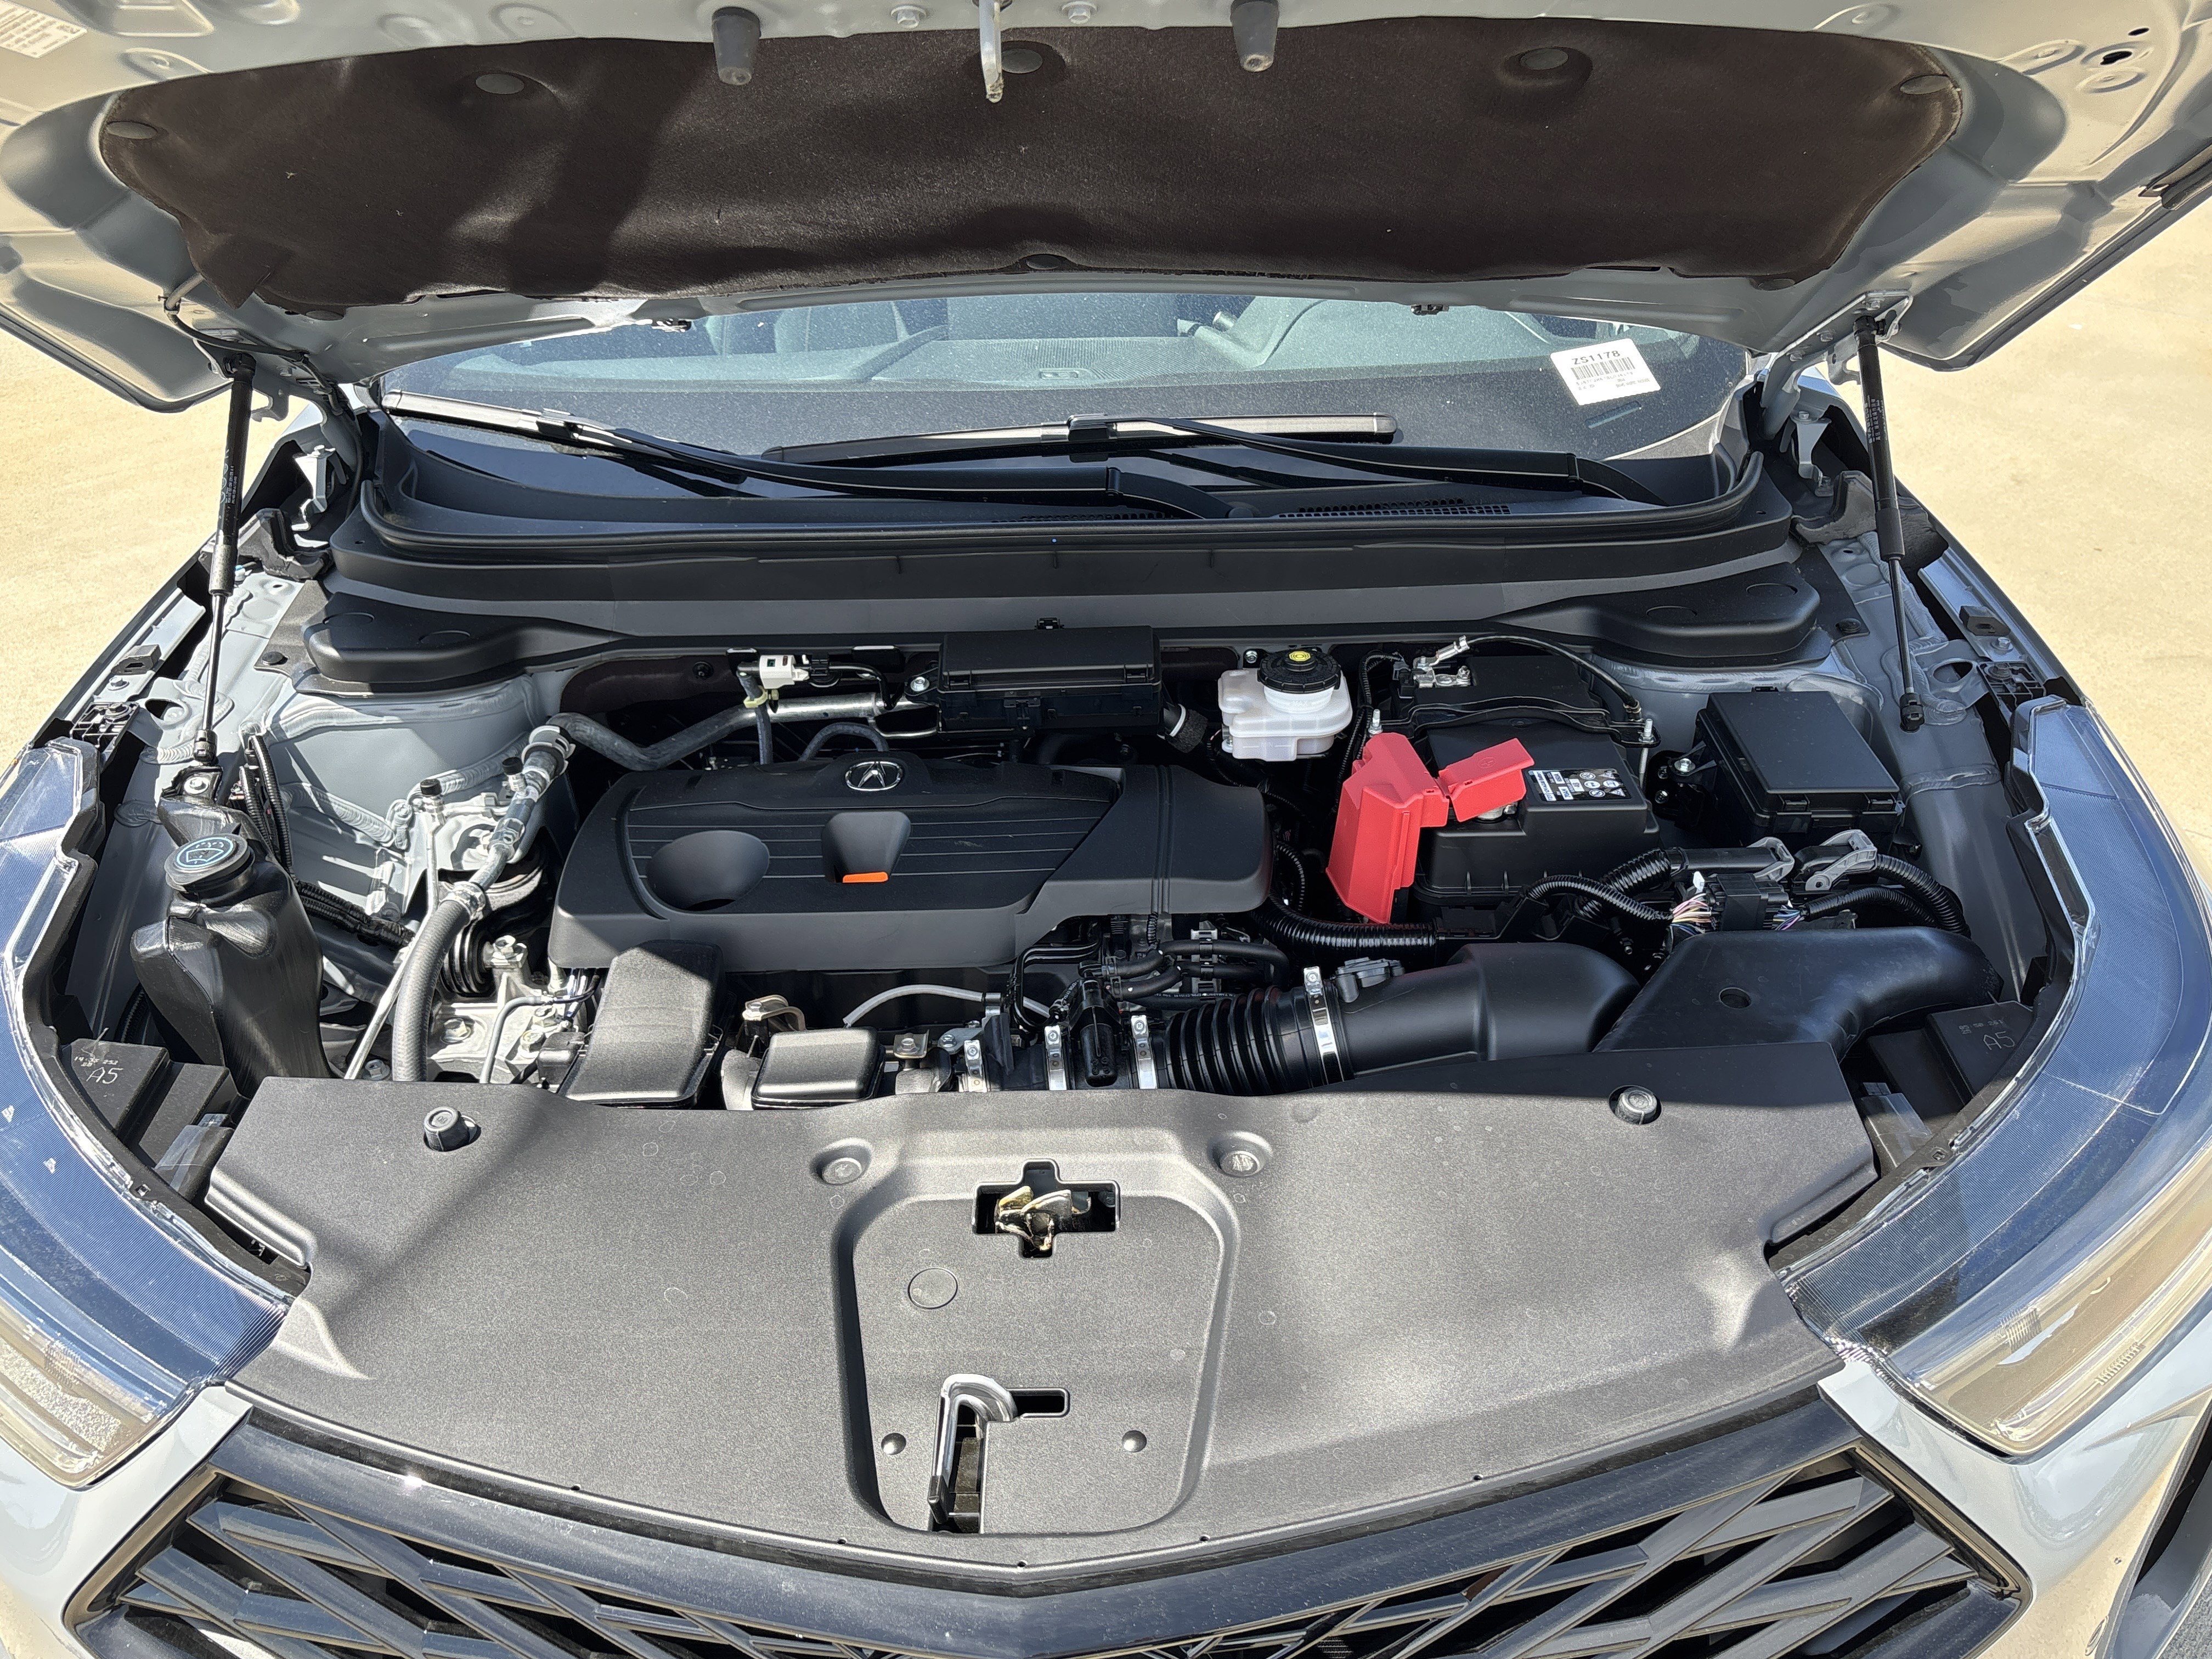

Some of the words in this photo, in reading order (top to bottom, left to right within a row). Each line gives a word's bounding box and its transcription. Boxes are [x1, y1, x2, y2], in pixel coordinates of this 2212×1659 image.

[1571, 350, 1621, 365] ZS1178
[1983, 1031, 2016, 1050] A5
[86, 1066, 124, 1085] A5
